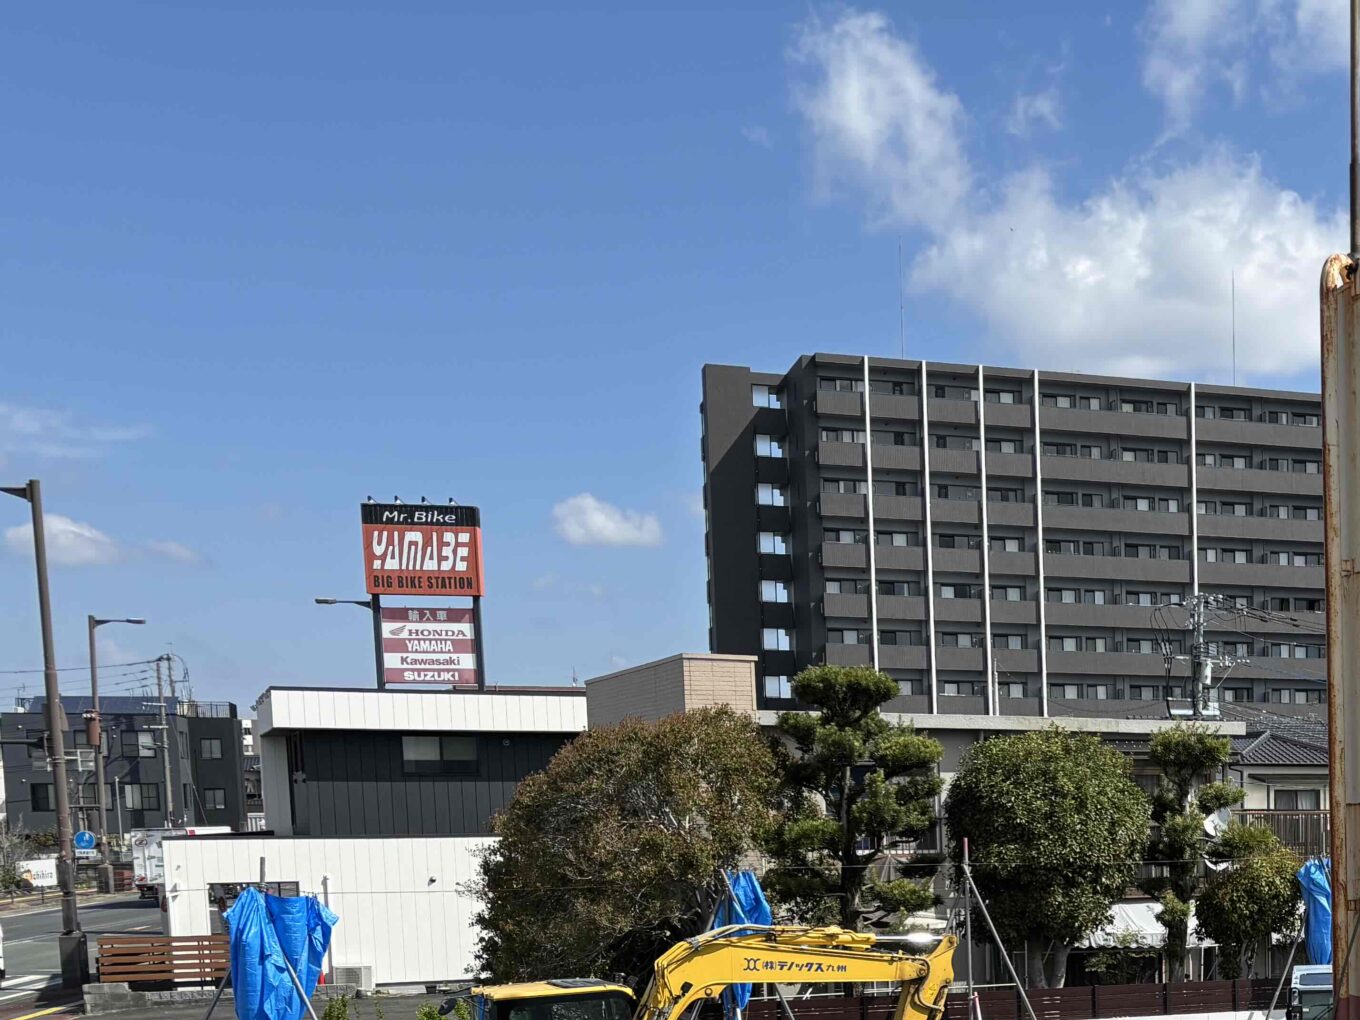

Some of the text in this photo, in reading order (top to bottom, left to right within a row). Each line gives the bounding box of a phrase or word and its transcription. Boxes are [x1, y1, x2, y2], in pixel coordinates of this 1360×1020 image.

[372, 530, 470, 571] YAMABE
[373, 575, 473, 590] BIG BIKE STATION
[408, 610, 447, 621] 輸入車
[407, 629, 467, 637] HONDA
[405, 640, 453, 652] YAMAHA
[400, 656, 460, 666] Kawasaki
[403, 671, 459, 681] SUZUKI
